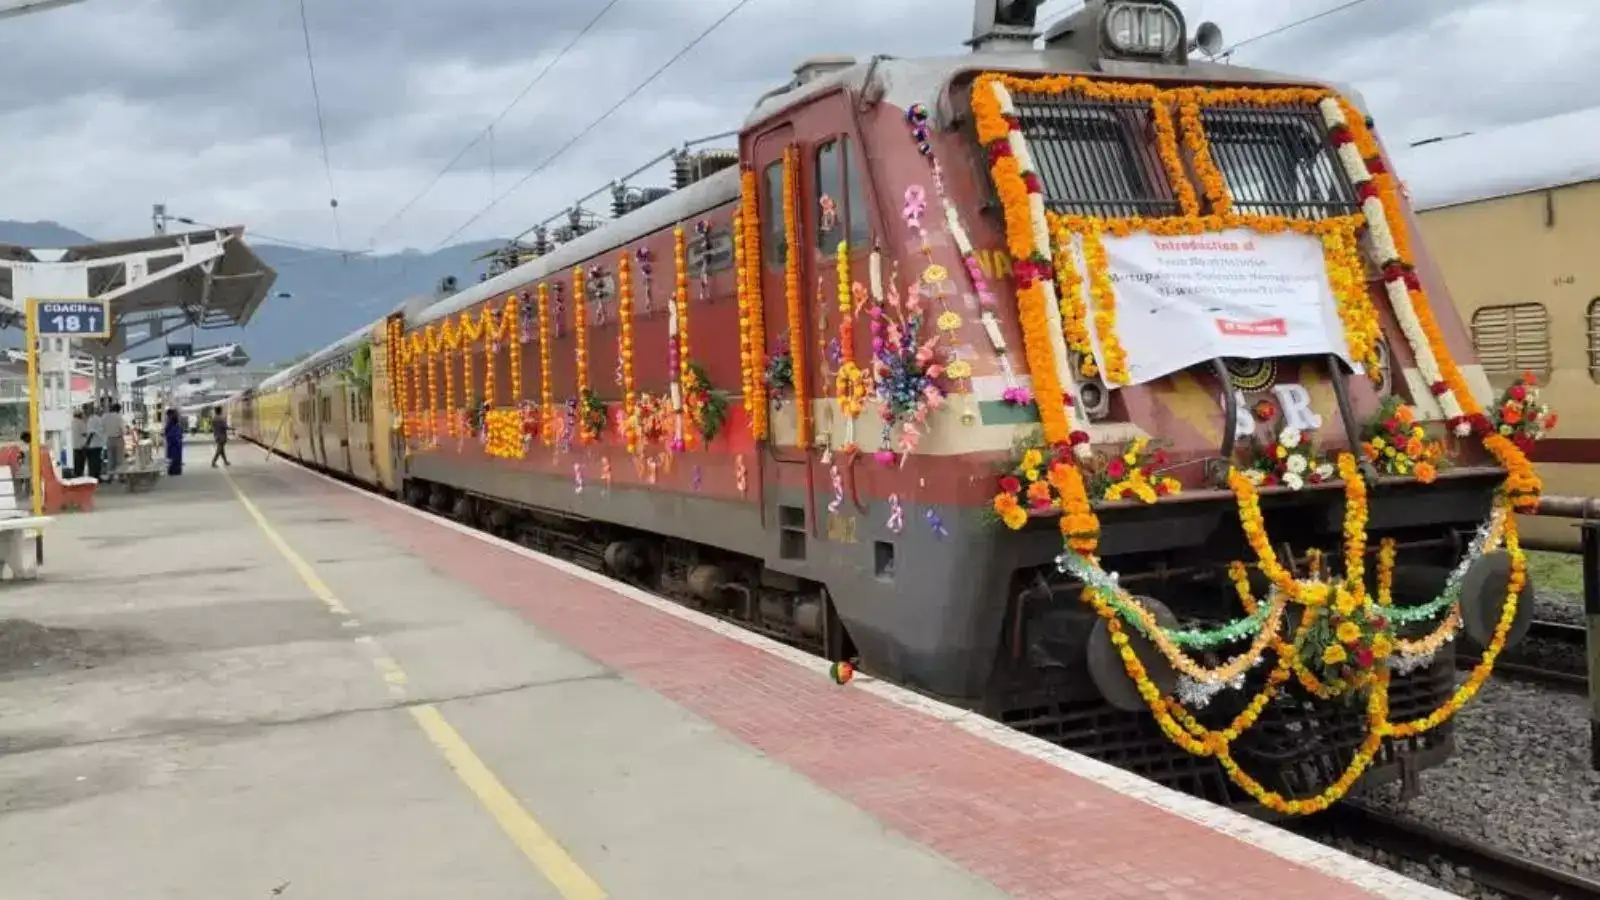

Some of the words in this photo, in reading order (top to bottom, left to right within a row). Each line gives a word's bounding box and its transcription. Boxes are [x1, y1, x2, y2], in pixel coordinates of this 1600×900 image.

[1154, 238, 1239, 250] Introduction
[43, 303, 87, 313] COACH
[51, 315, 81, 332] 18
[1273, 383, 1322, 431] R
